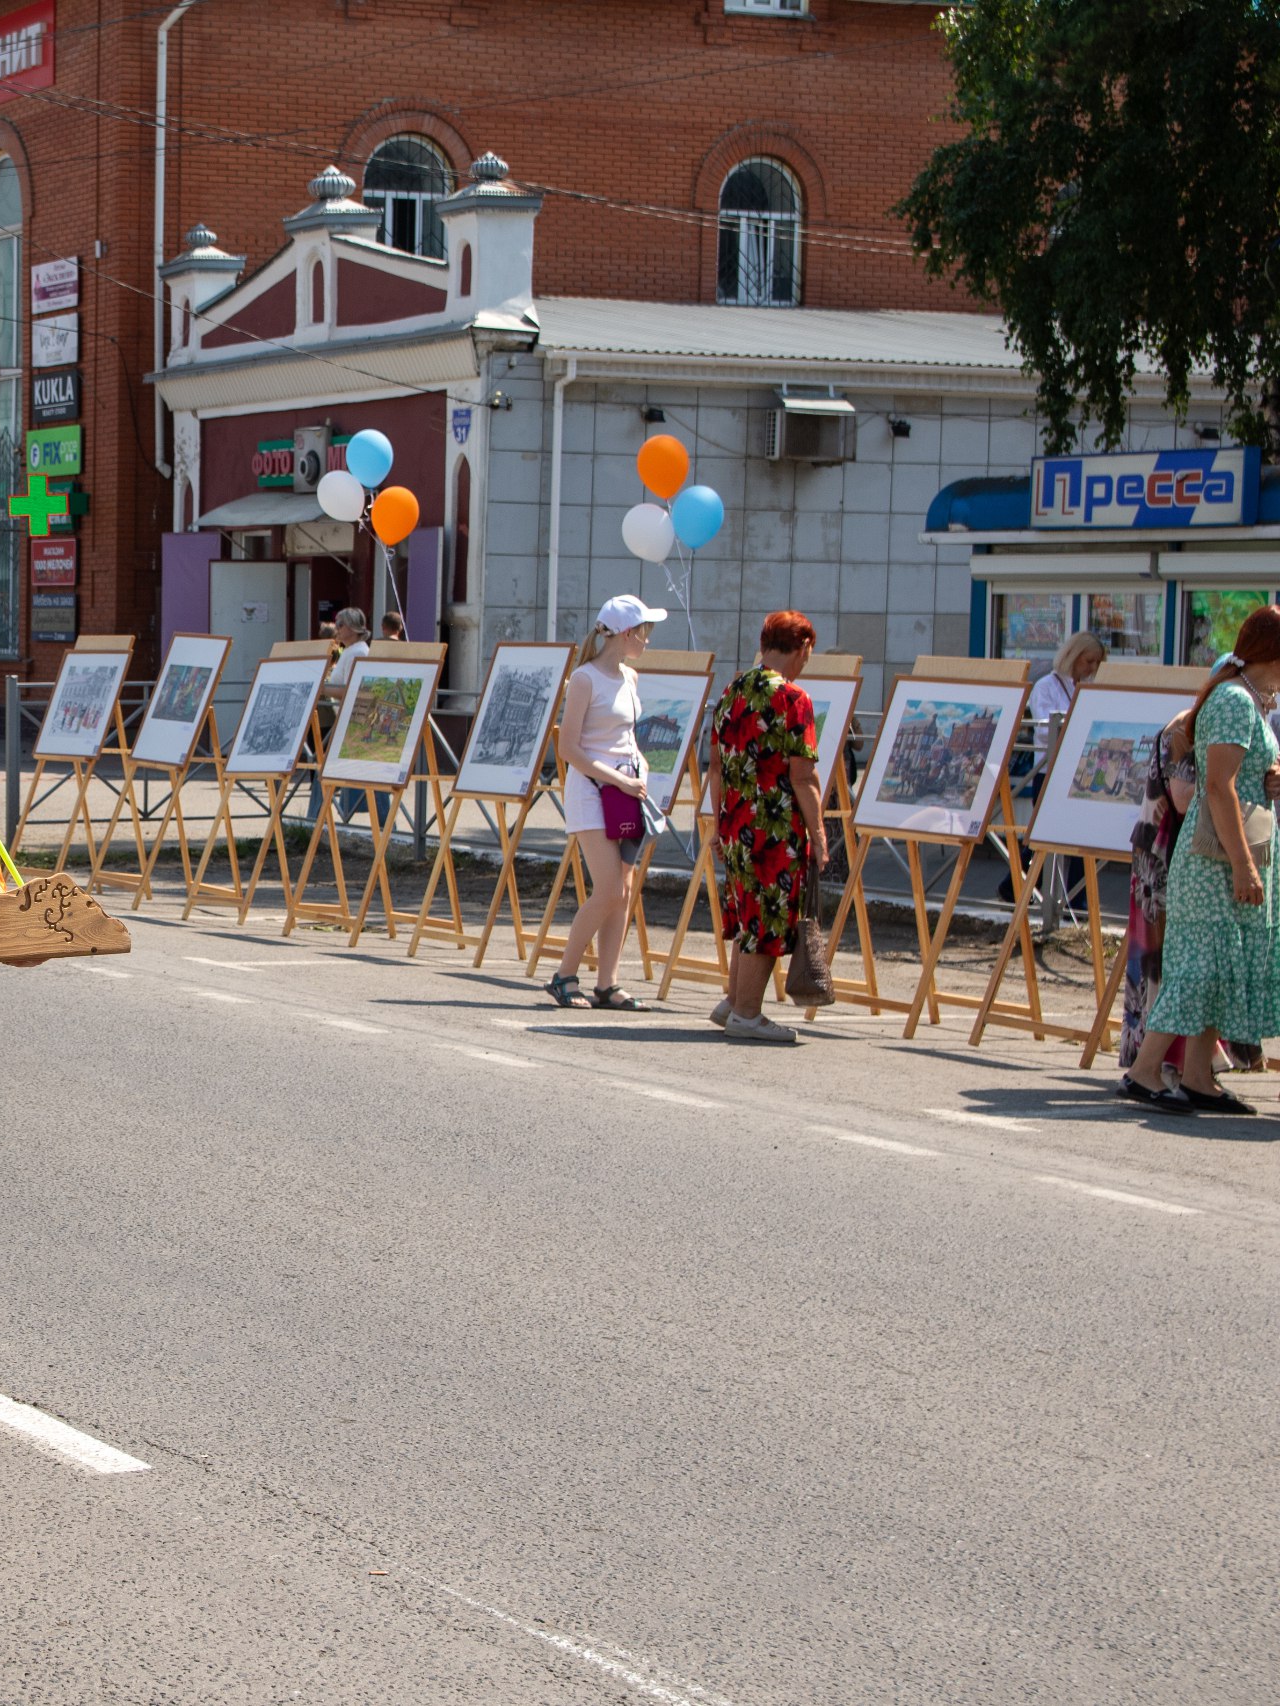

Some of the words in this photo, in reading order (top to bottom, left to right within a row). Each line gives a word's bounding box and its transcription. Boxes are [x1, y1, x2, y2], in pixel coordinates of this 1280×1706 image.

[34, 375, 74, 406] KUKLA
[455, 427, 467, 441] 31
[43, 441, 61, 466] FIX
[251, 449, 291, 477] ФОТО
[1036, 459, 1235, 523] Пресса
[47, 556, 73, 571] МЕЛОЧЕЙ
